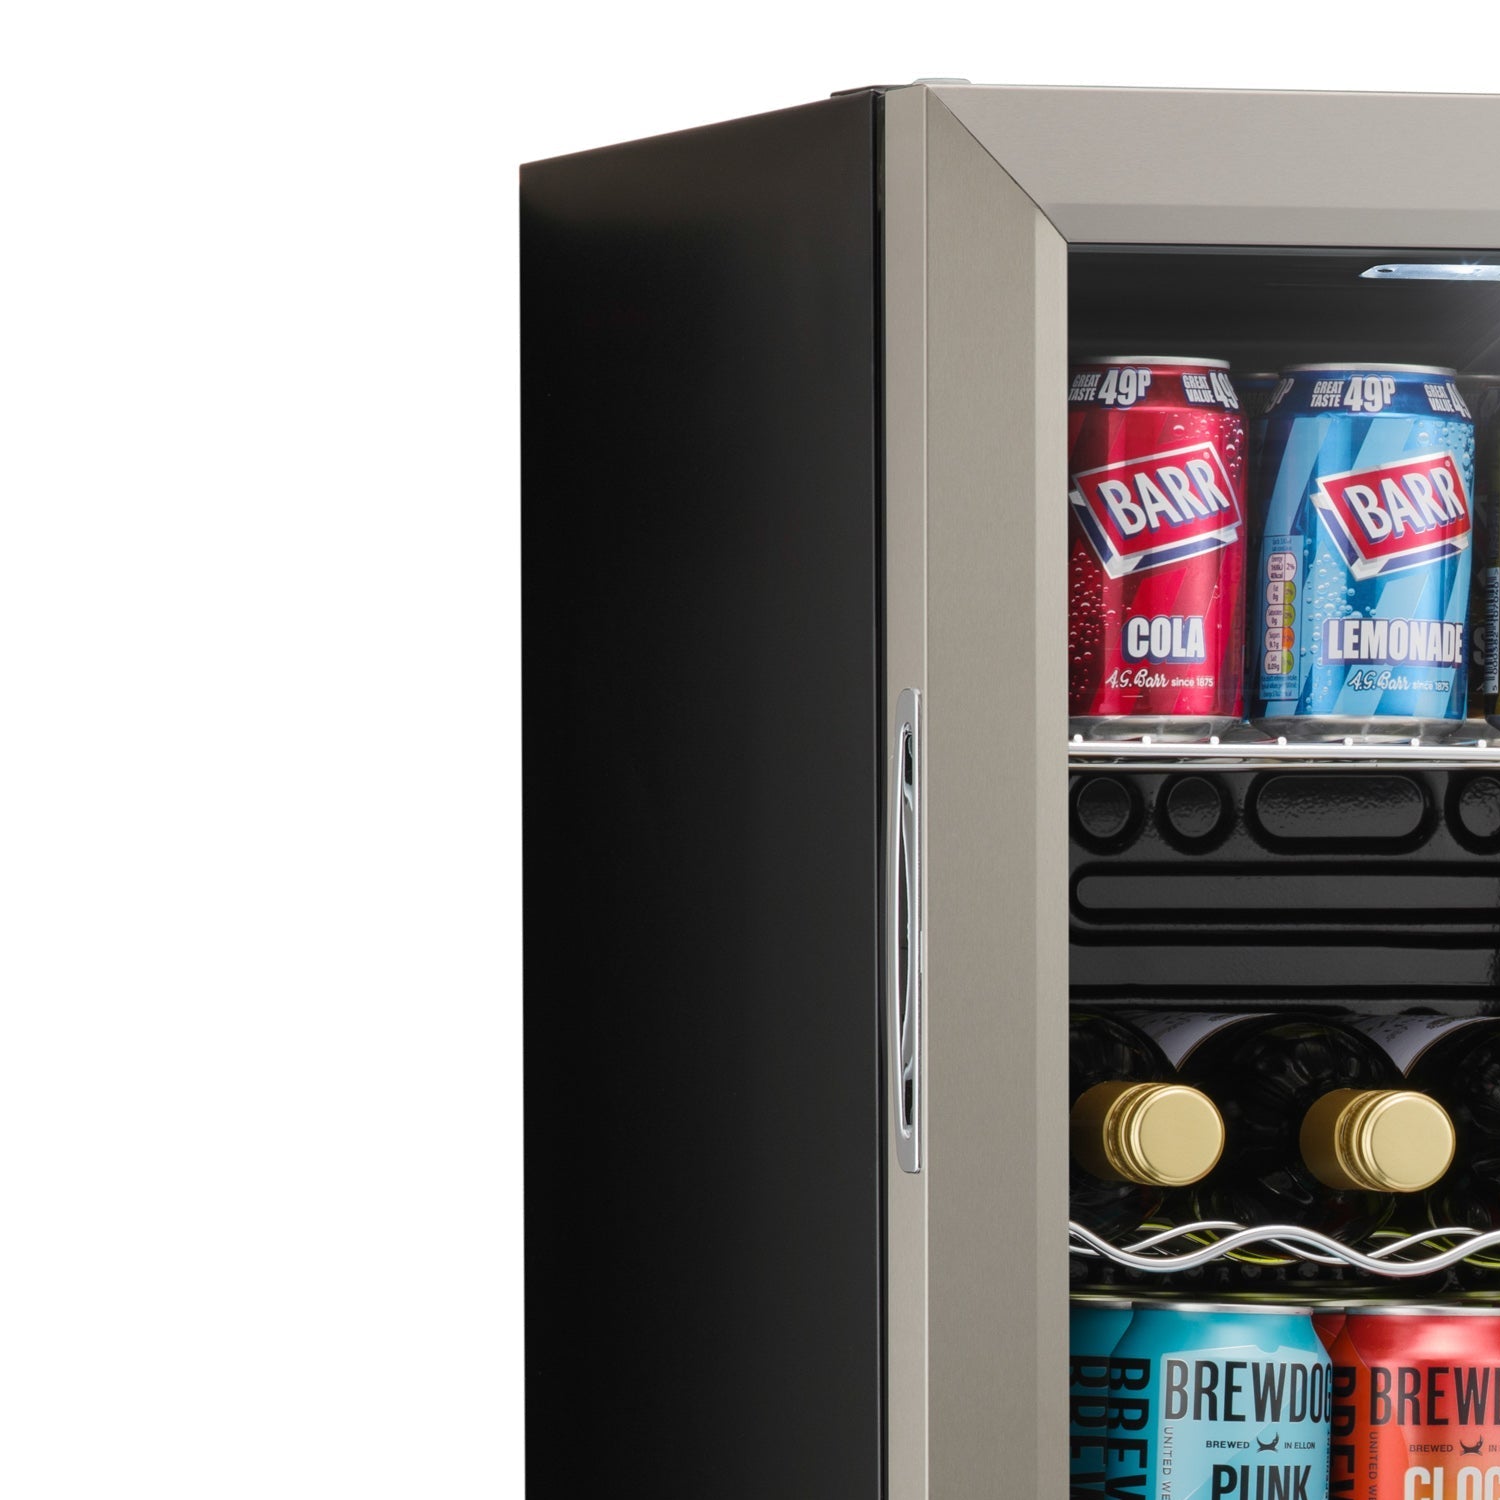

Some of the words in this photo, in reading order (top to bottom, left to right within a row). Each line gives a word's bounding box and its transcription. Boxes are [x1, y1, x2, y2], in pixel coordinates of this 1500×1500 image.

[1073, 374, 1100, 387] GREAT
[1182, 375, 1209, 389] GREAT
[1313, 381, 1344, 394] GREAT
[1068, 388, 1096, 401] TASTE
[1310, 394, 1341, 407] TASTE
[1098, 459, 1230, 535] BARR
[1344, 467, 1464, 540] BARR
[1127, 616, 1205, 660] COLA
[1328, 619, 1463, 664] LEMONADE
[1196, 677, 1214, 687] 1875
[1162, 1427, 1174, 1475] UNITED
[1206, 1440, 1250, 1449] BREWED
[1409, 1444, 1454, 1453] BREWED
[1161, 1482, 1171, 1500] WE
